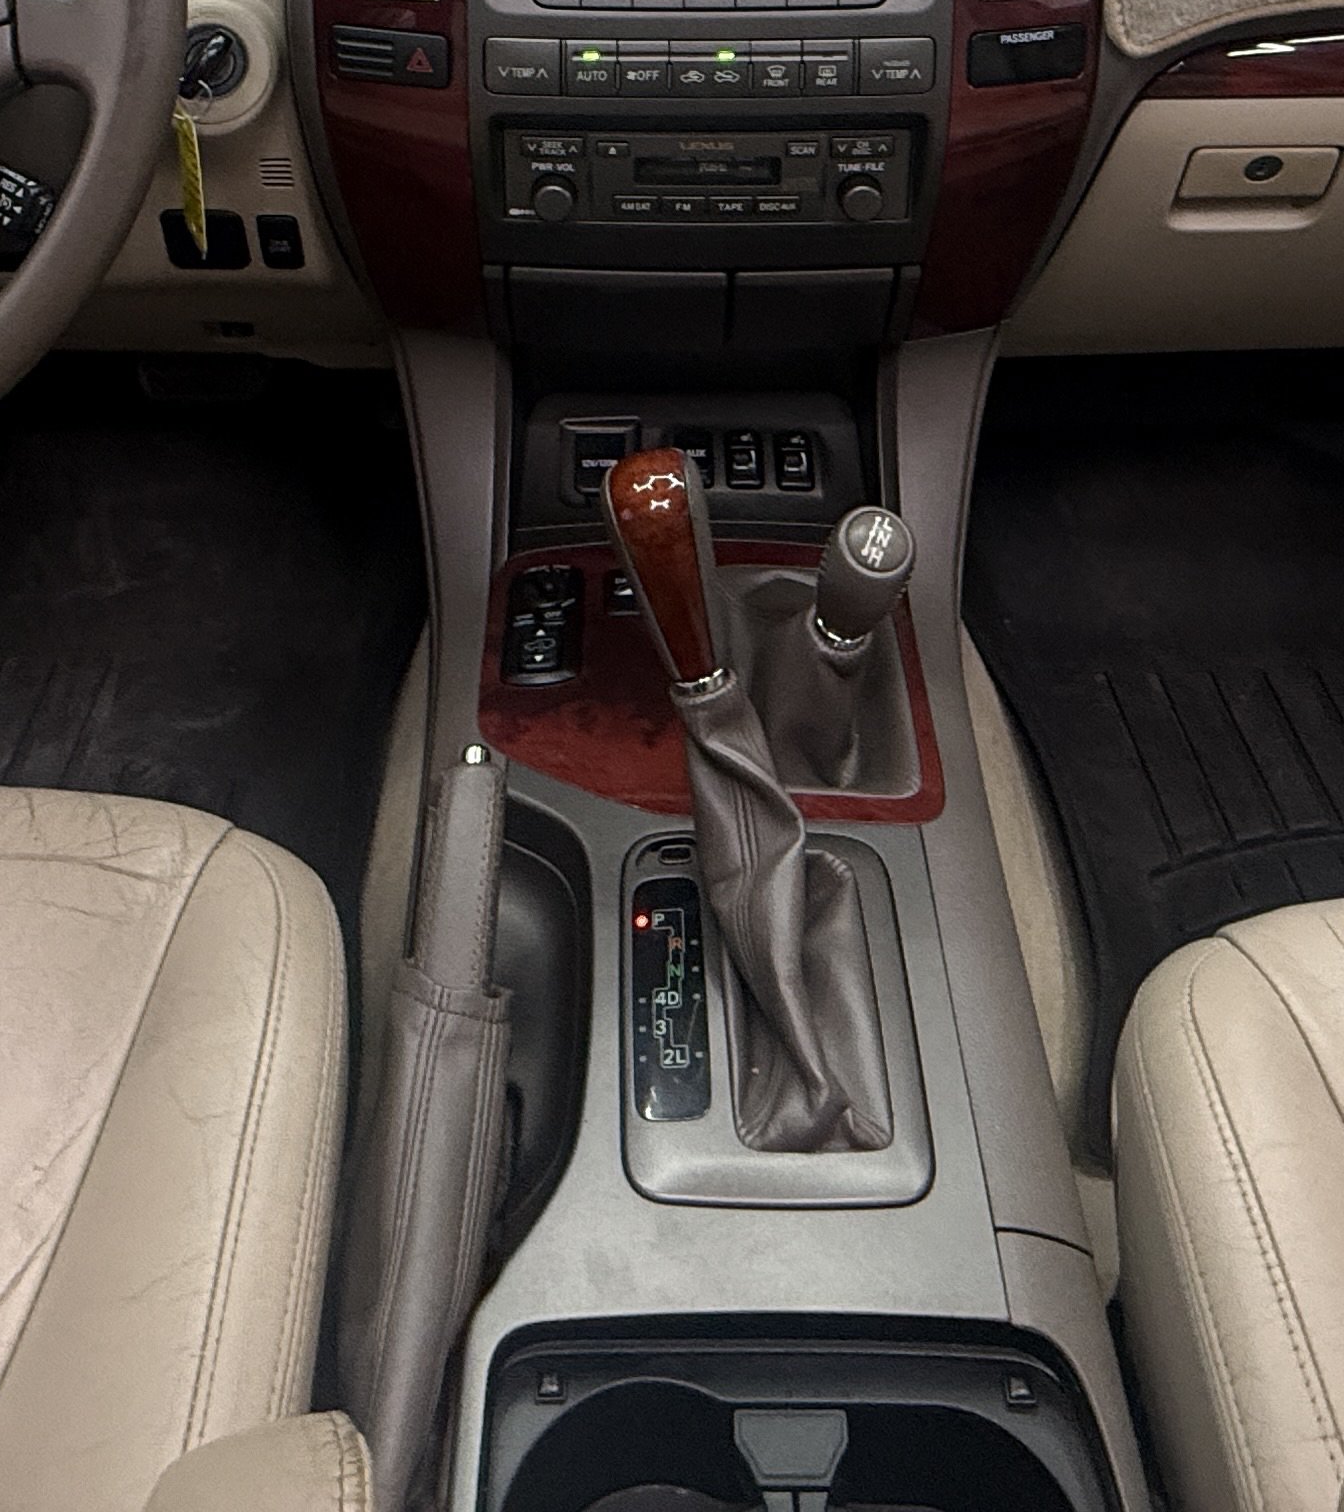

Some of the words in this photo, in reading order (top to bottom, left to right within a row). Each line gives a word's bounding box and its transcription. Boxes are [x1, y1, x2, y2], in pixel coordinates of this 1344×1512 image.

[1000, 30, 1054, 44] PASSENGER
[512, 68, 535, 78] TEMP
[576, 70, 607, 82] AUTO
[637, 71, 659, 81] OFF
[885, 70, 910, 79] TEMP
[763, 78, 789, 87] FRONT
[816, 77, 838, 86] REAR
[791, 146, 815, 155] SCAN
[676, 203, 691, 211] FM
[718, 203, 743, 211] TAPE
[883, 517, 893, 531] L
[876, 530, 891, 548] N
[867, 546, 884, 568] H
[655, 913, 665, 926] P
[672, 937, 682, 949] R
[671, 964, 682, 977] N
[656, 1020, 667, 1035] 3
